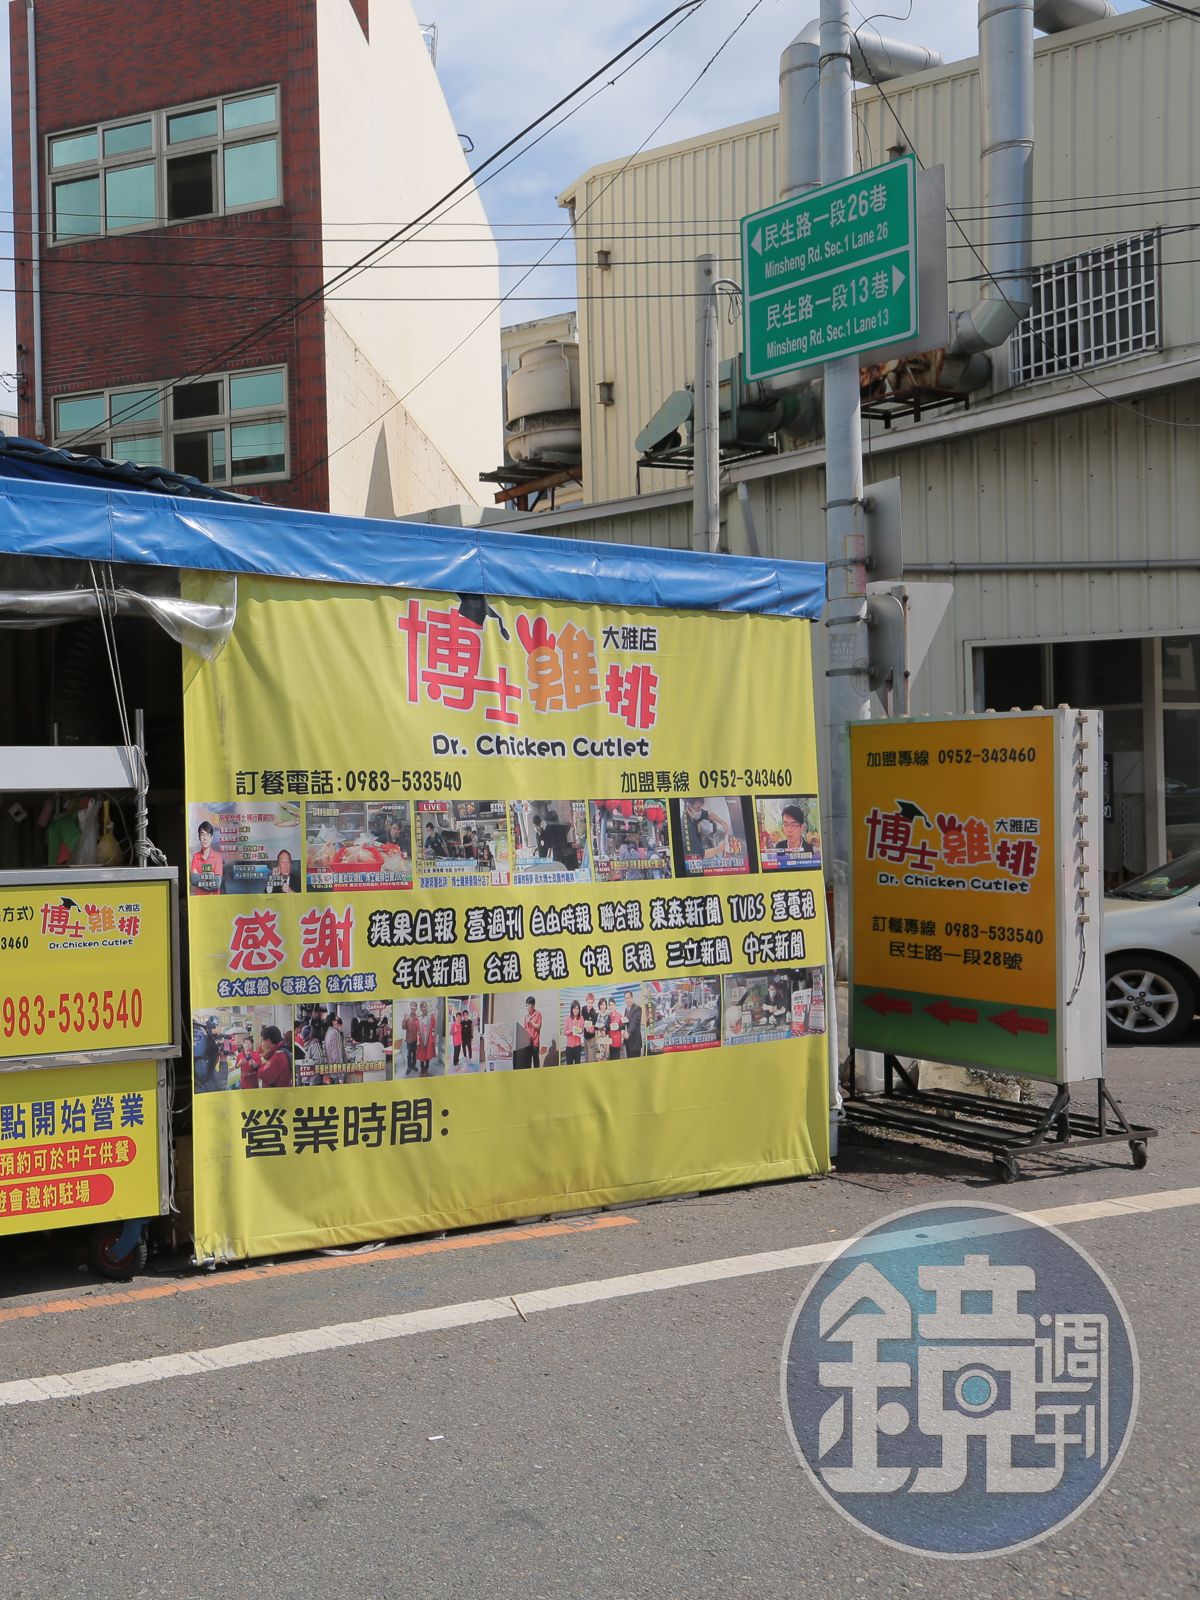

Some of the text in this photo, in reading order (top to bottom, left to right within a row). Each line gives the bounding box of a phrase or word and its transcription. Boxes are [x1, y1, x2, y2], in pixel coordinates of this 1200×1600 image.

[764, 184, 887, 252] 民生路一段26巷
[765, 254, 806, 279] Minsheng
[808, 244, 823, 265] Rd.
[851, 231, 875, 250] Lane
[877, 221, 888, 241] 26
[766, 270, 889, 331] 民生路一段13巷
[766, 336, 808, 359] Minsheng
[810, 328, 824, 347] Rd.
[602, 626, 657, 651] 大雅店
[397, 599, 660, 731] 博士雞排
[432, 734, 650, 758] Dr. Chicken Cutlet
[866, 747, 1036, 767] 加盟專線 0952-343460
[620, 767, 793, 794] 加盟專線 0952-343460
[423, 803, 441, 811] LIVE
[995, 819, 1038, 833] 大雅店
[865, 809, 1038, 877] 博士雞排
[878, 873, 1029, 892] Dr. Chicken Cutlet
[40, 903, 140, 939] 博士雞排
[118, 904, 140, 912] 大雅店
[369, 890, 816, 946] 蘋果日報 壹週刊 自由時報 聯合報 東森新聞 TVBS 壹電視
[101, 938, 134, 947] Cutlet
[229, 905, 354, 971] 感謝
[872, 915, 1044, 945] 訂餐專線 0983-533540
[394, 930, 805, 987] 年代新聞 台視 華視 中視 民視 三立新聞 中天新聞
[889, 941, 1023, 971] 民生路一段28號
[218, 972, 377, 997] 各大媒體、電視台 強力報導
[240, 1098, 450, 1158] 營業時間:
